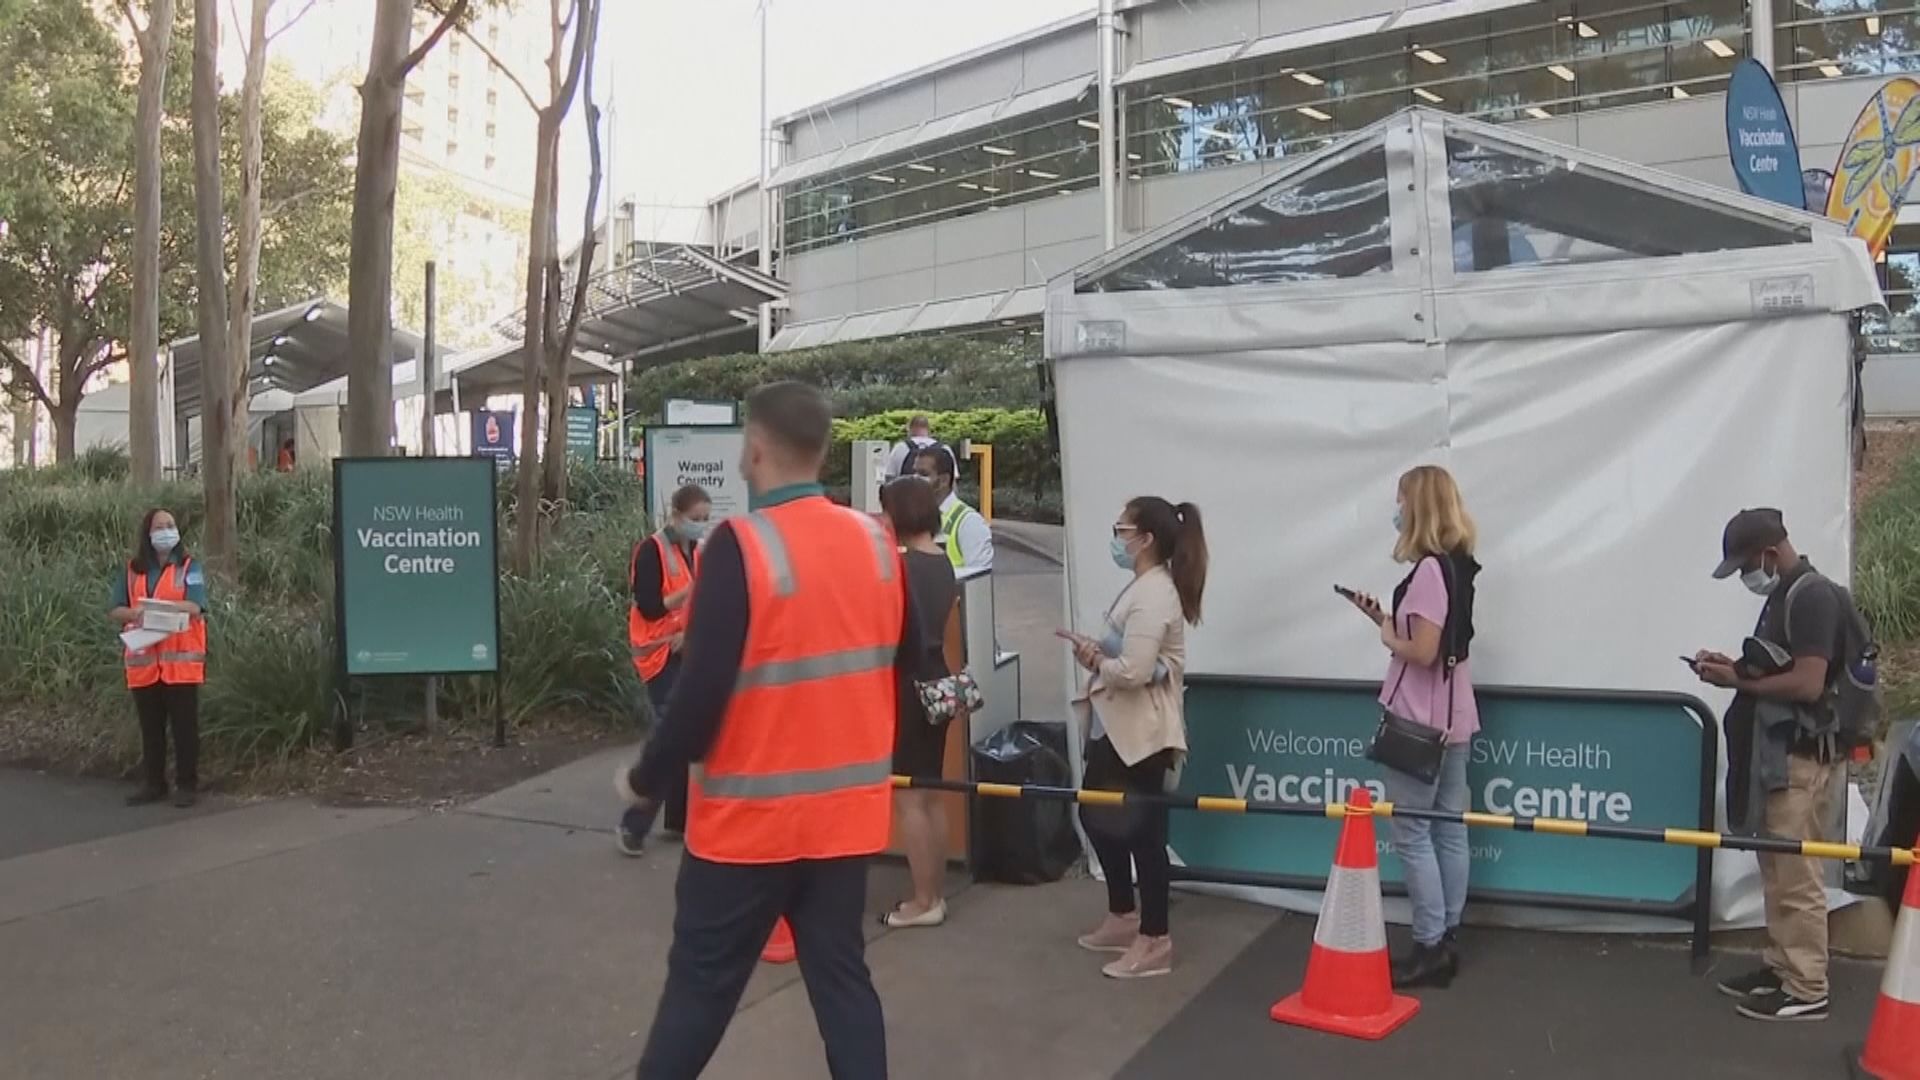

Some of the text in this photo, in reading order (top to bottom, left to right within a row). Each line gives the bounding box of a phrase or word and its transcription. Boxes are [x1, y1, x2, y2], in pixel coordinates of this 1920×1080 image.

[1739, 128, 1786, 146] Vaccination
[1750, 154, 1778, 172] Centre
[677, 460, 724, 473] Wangal
[373, 505, 464, 521] NSW Health
[357, 527, 481, 548] Vaccination
[384, 554, 455, 574] Centre
[1247, 728, 1612, 769] Welcome SW Health
[1484, 777, 1633, 822] Centre
[1470, 844, 1502, 862] only
